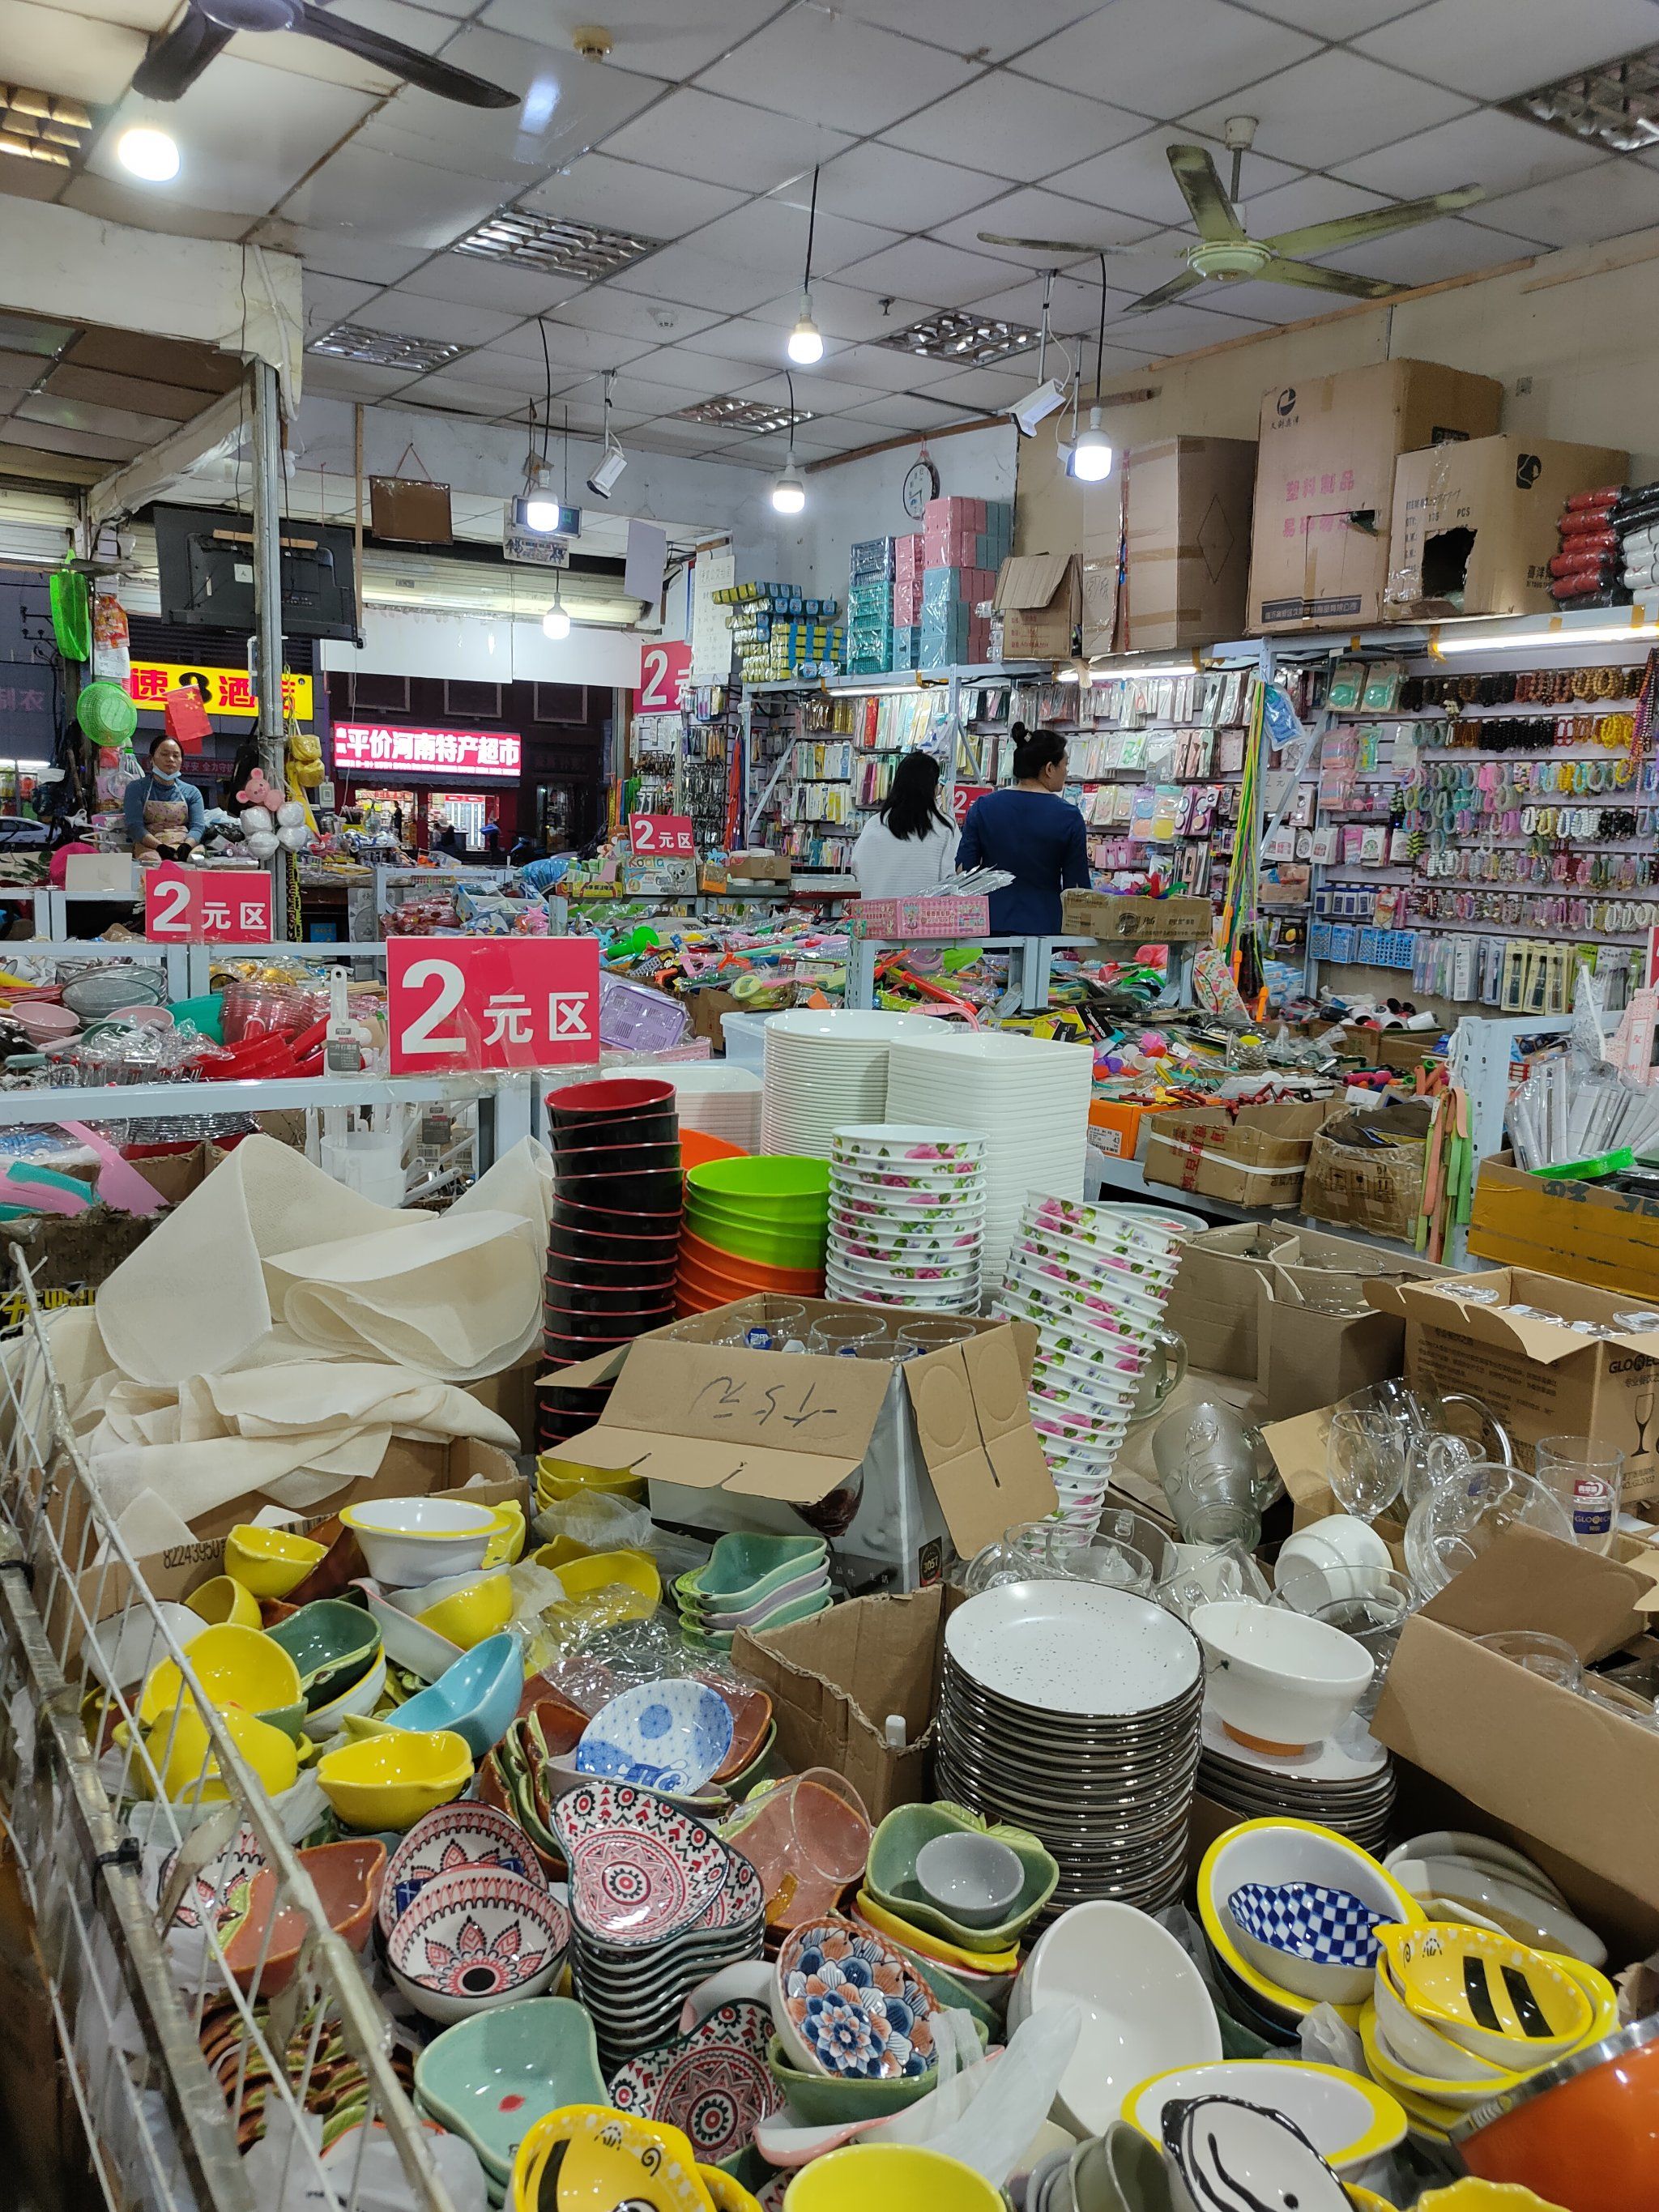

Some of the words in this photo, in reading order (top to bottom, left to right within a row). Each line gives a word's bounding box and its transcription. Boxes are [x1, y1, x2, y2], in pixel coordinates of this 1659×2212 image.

[1456, 506, 1470, 518] PCS
[346, 728, 521, 766] 平价河南特产超市
[634, 820, 693, 850] 2元区
[628, 855, 665, 869] Koala
[152, 880, 267, 932] 2元区
[401, 958, 592, 1055] 2元区
[923, 1555, 939, 1574] 3057
